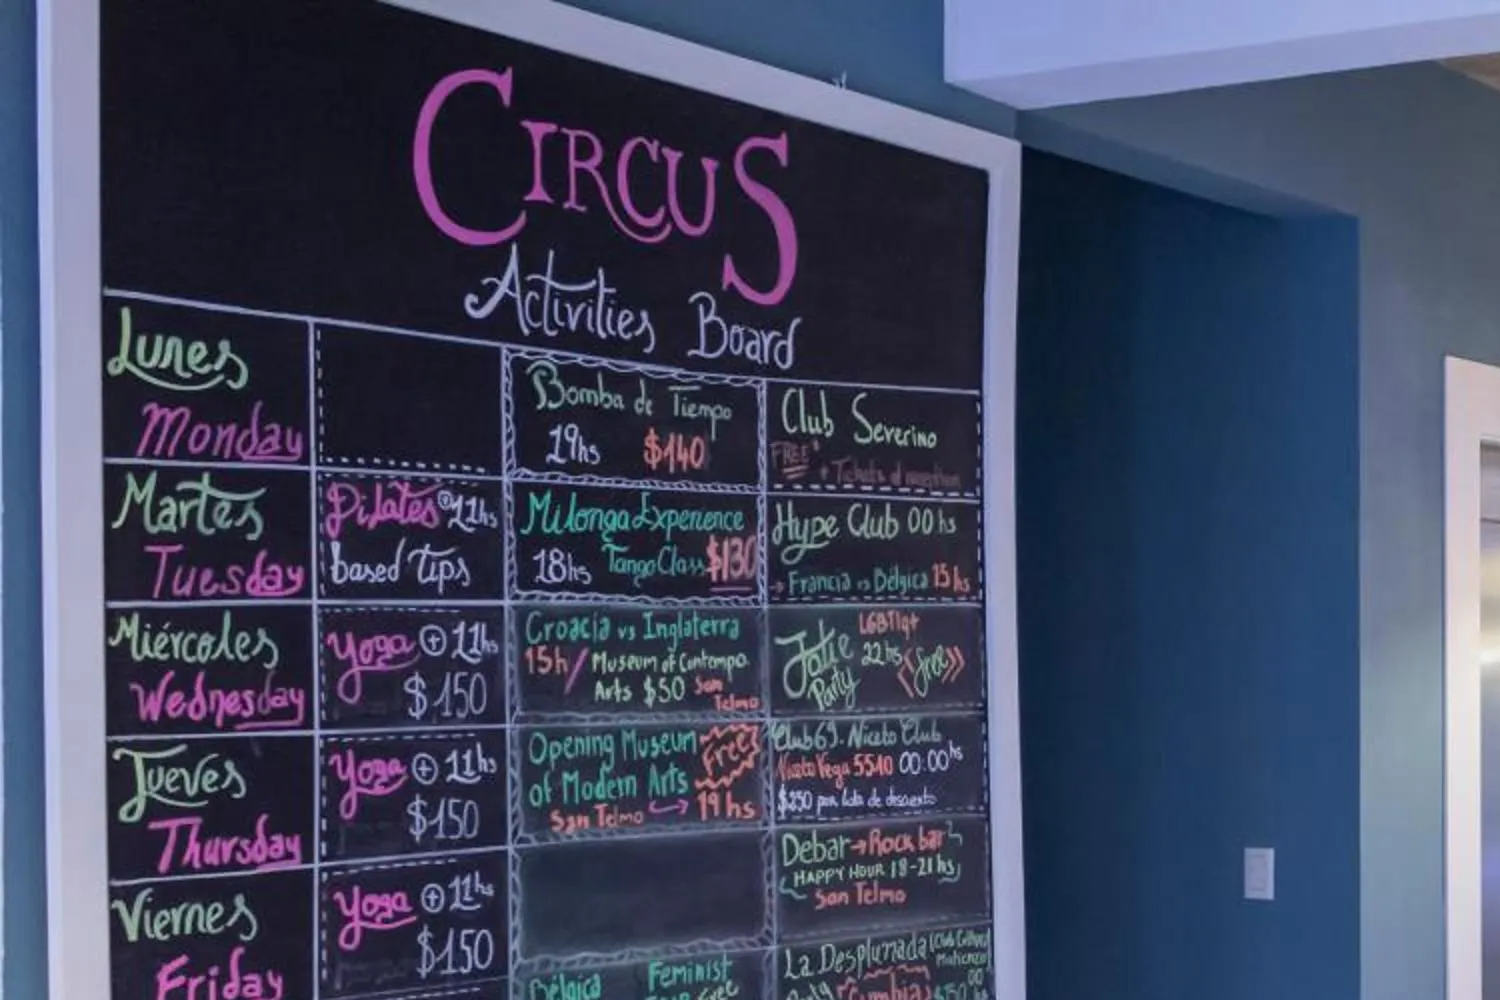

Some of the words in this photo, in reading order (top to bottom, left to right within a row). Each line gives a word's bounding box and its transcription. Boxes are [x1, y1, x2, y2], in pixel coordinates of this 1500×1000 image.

[464, 242, 655, 353] Activities
[688, 291, 801, 369] Board
[107, 306, 249, 391] Lunes
[526, 360, 625, 410] Bomba
[634, 378, 653, 416] de
[668, 385, 733, 442] Tiempo
[781, 387, 835, 438] Club
[851, 392, 938, 448] Severino
[136, 400, 303, 461] Monday
[643, 427, 706, 474] $140
[112, 470, 267, 541] Martes
[325, 480, 445, 539] Pilates
[520, 490, 630, 543] Milonga
[771, 500, 840, 565] Hype
[847, 502, 899, 540] Club
[143, 544, 305, 599] Tuesday
[330, 536, 406, 584] based
[602, 543, 656, 588] Tango
[657, 545, 707, 577] Class
[788, 570, 851, 595] Francia
[108, 609, 279, 669] Miércoles
[525, 610, 611, 645] Croacia
[618, 628, 636, 641] vs
[643, 610, 740, 652] Inglaterra
[327, 631, 422, 705] Yoga
[591, 651, 657, 673] Museum
[661, 655, 678, 674] of
[694, 676, 724, 695] San
[129, 670, 305, 731] Wednesday
[594, 678, 633, 703] Arts
[643, 675, 686, 709] $50
[714, 694, 761, 712] Telmo
[807, 665, 862, 712] Party
[529, 731, 616, 773] Opening
[621, 728, 698, 762] Museum
[848, 718, 897, 749] Niceto
[901, 716, 943, 747] Club
[112, 744, 247, 824] Jueves
[328, 749, 410, 820] Yoga
[529, 770, 552, 808] of
[562, 767, 638, 805] Modern
[649, 762, 690, 800] Arts
[853, 752, 894, 777] 5510
[406, 794, 479, 844] $150
[551, 808, 590, 834] San
[593, 802, 645, 830] Telmo
[867, 786, 883, 808] de
[148, 813, 302, 875] Thursday
[781, 829, 850, 868] Debar
[868, 827, 914, 857] Rock
[917, 824, 946, 852] bar
[793, 866, 845, 888] HAPPY
[849, 861, 886, 880] HOUR
[814, 888, 850, 910] San
[855, 880, 907, 906] Telmo
[112, 887, 258, 942] Viernes
[333, 885, 418, 951] Yoga
[416, 923, 494, 980] $150
[649, 954, 733, 995] Feminist
[783, 949, 813, 980] La
